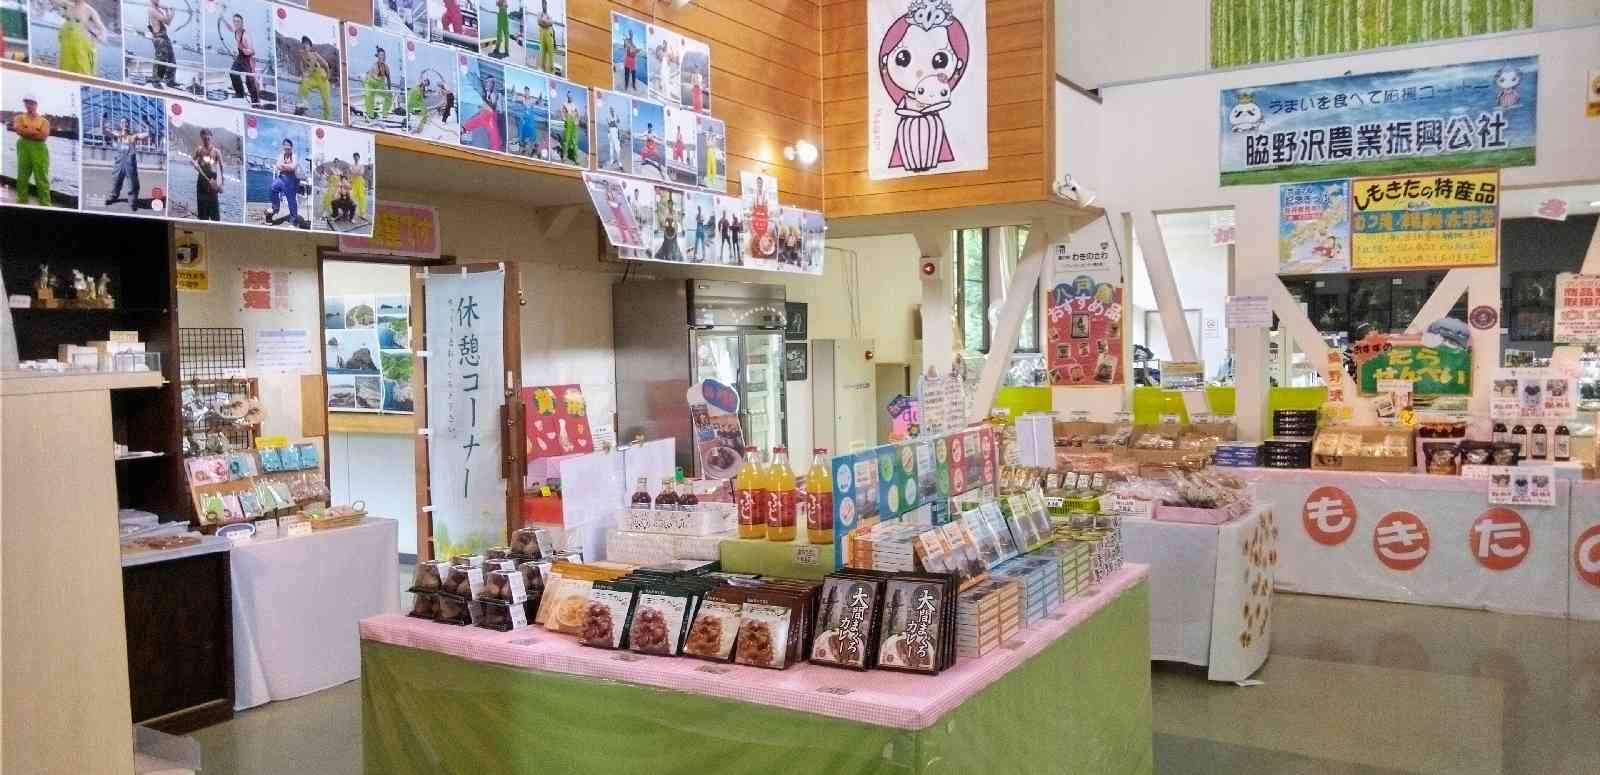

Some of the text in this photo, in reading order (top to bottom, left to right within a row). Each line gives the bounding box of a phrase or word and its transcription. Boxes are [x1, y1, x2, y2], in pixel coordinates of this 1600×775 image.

[1246, 113, 1506, 167] 脇野沢農業振興公社
[1353, 178, 1496, 210] しもきたの特産品
[457, 295, 481, 498] 休憩コーナー
[838, 617, 851, 654] カレー
[848, 587, 870, 653] 大間まぐろ
[906, 620, 919, 657] カレー
[916, 589, 937, 658] 大間まぐろ
